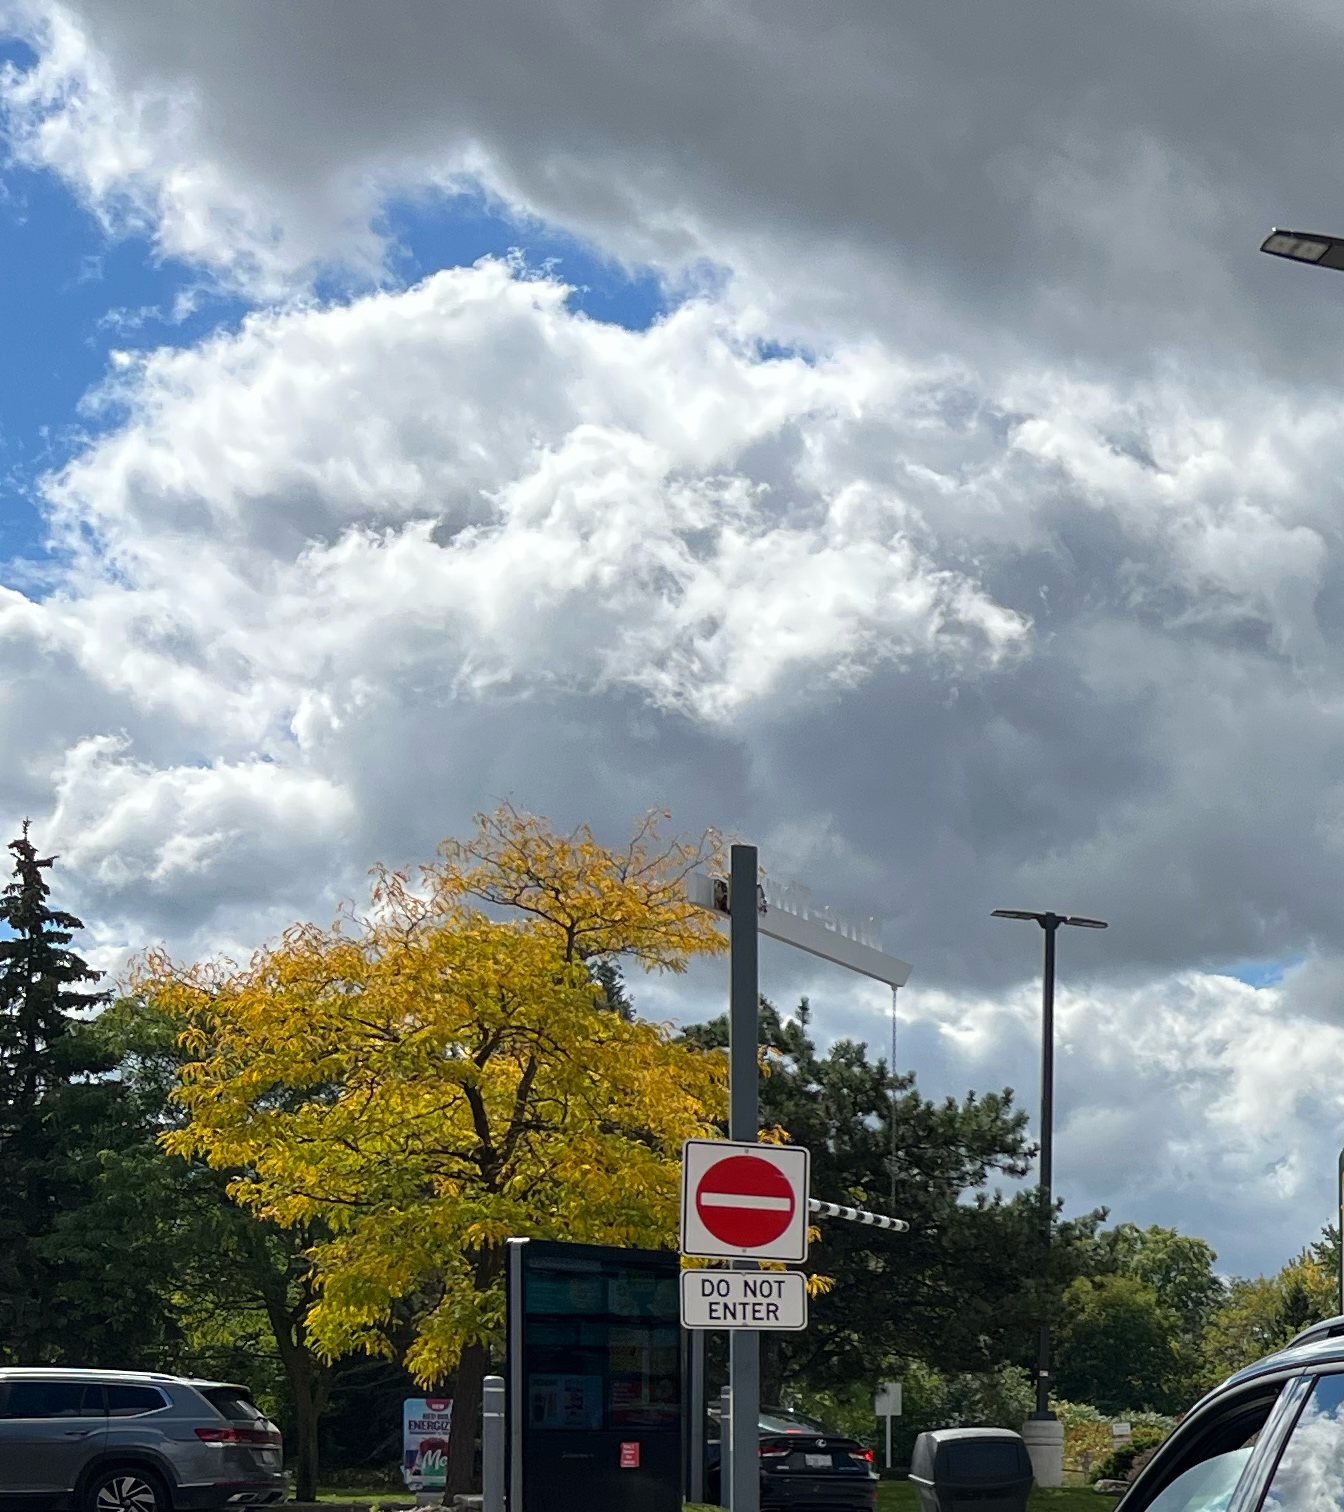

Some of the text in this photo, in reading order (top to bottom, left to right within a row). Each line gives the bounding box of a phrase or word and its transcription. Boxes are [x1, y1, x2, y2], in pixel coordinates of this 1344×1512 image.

[701, 1279, 785, 1298] DO NOT
[709, 1302, 779, 1320] ENTER
[409, 1420, 450, 1430] ENERGIZ
